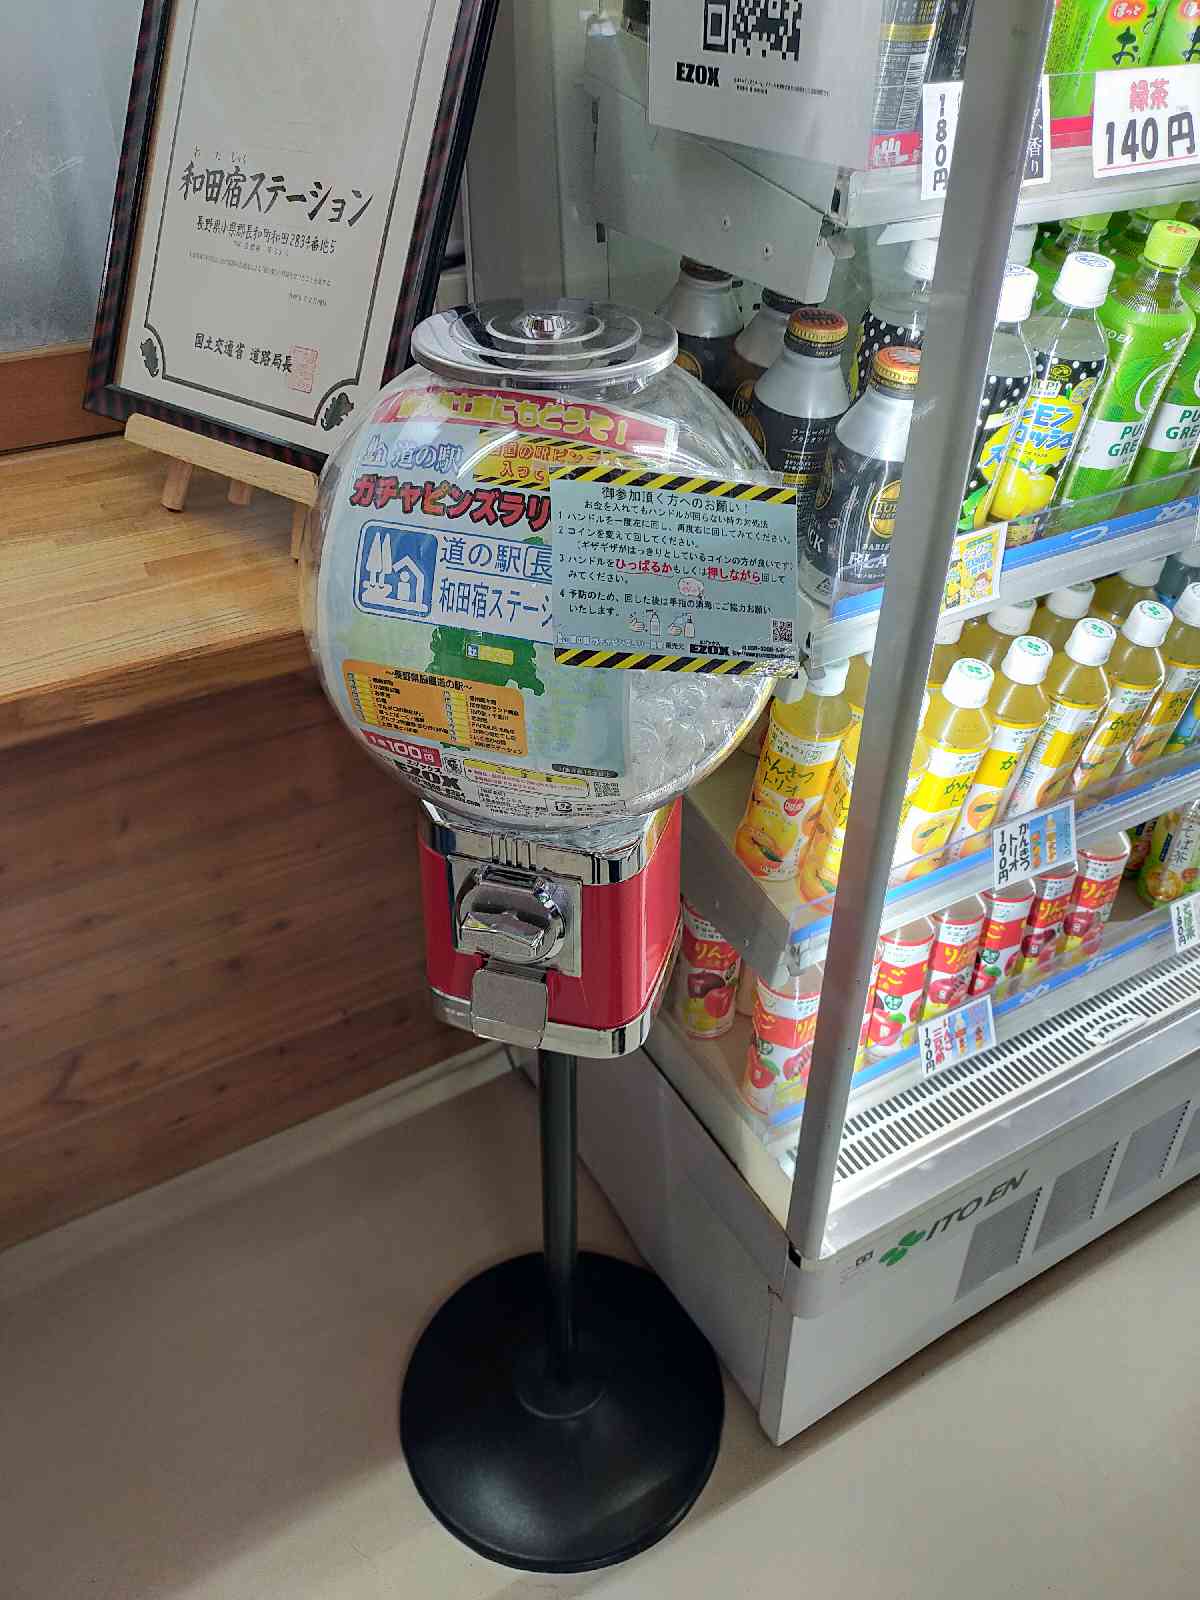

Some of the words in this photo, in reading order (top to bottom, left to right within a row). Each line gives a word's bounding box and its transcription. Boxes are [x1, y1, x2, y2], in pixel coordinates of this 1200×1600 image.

[676, 61, 720, 87] EZOX
[178, 160, 375, 227] 和田宿ステーション
[440, 535, 521, 574] 道の駅
[926, 1196, 983, 1241] ITO
[983, 1168, 1030, 1208] EN
